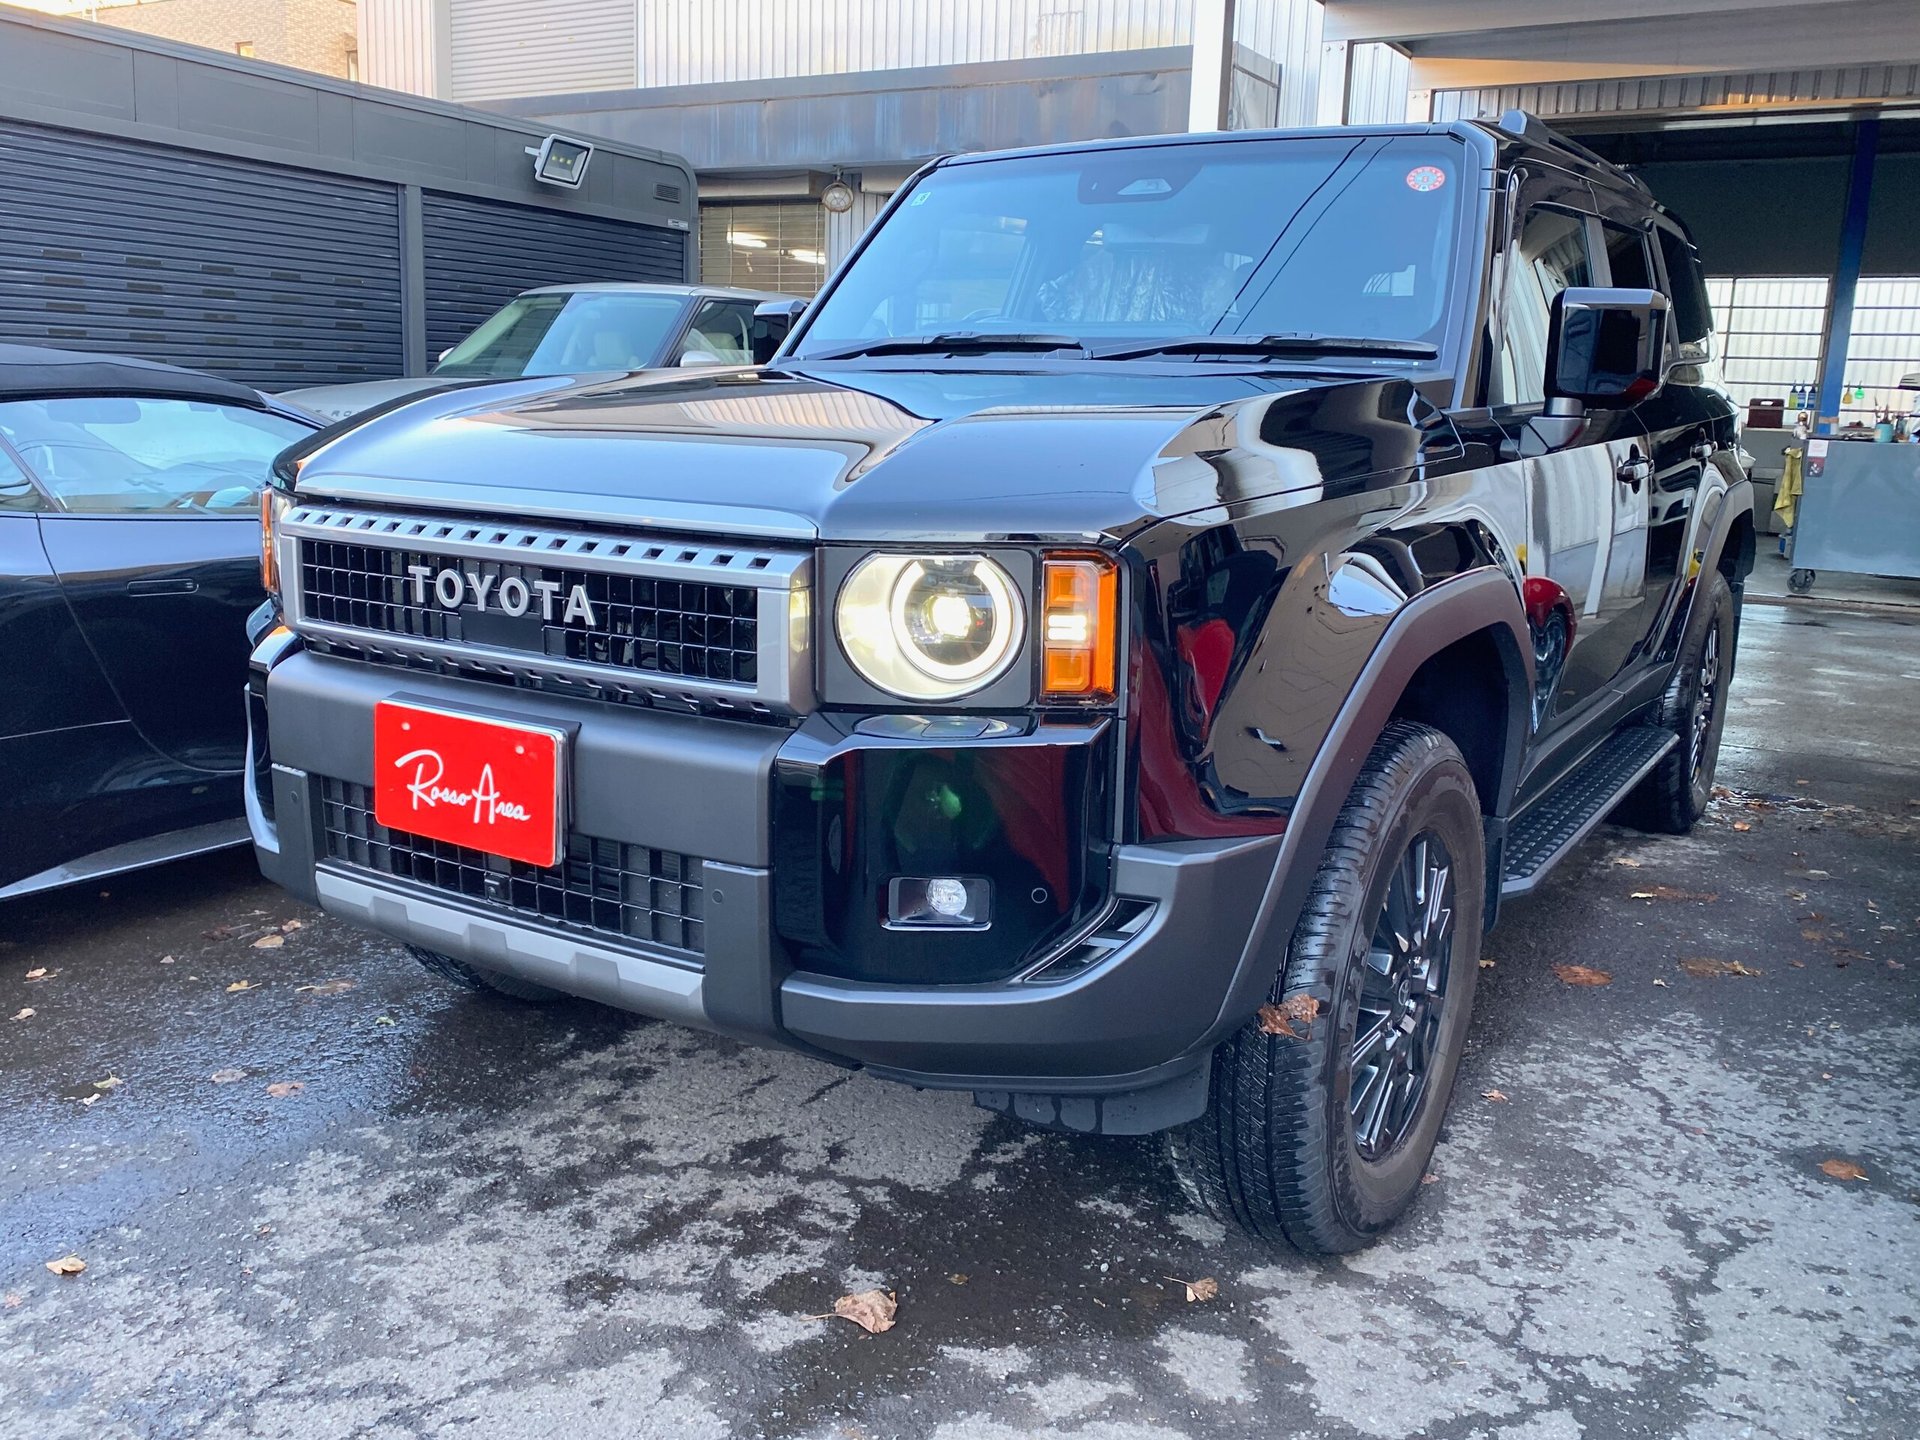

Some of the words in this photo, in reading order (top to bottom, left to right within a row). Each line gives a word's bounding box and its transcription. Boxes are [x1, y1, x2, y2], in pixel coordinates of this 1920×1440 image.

[407, 565, 597, 627] TOYOTA
[394, 748, 472, 811] Rosso
[471, 763, 532, 825] Area
